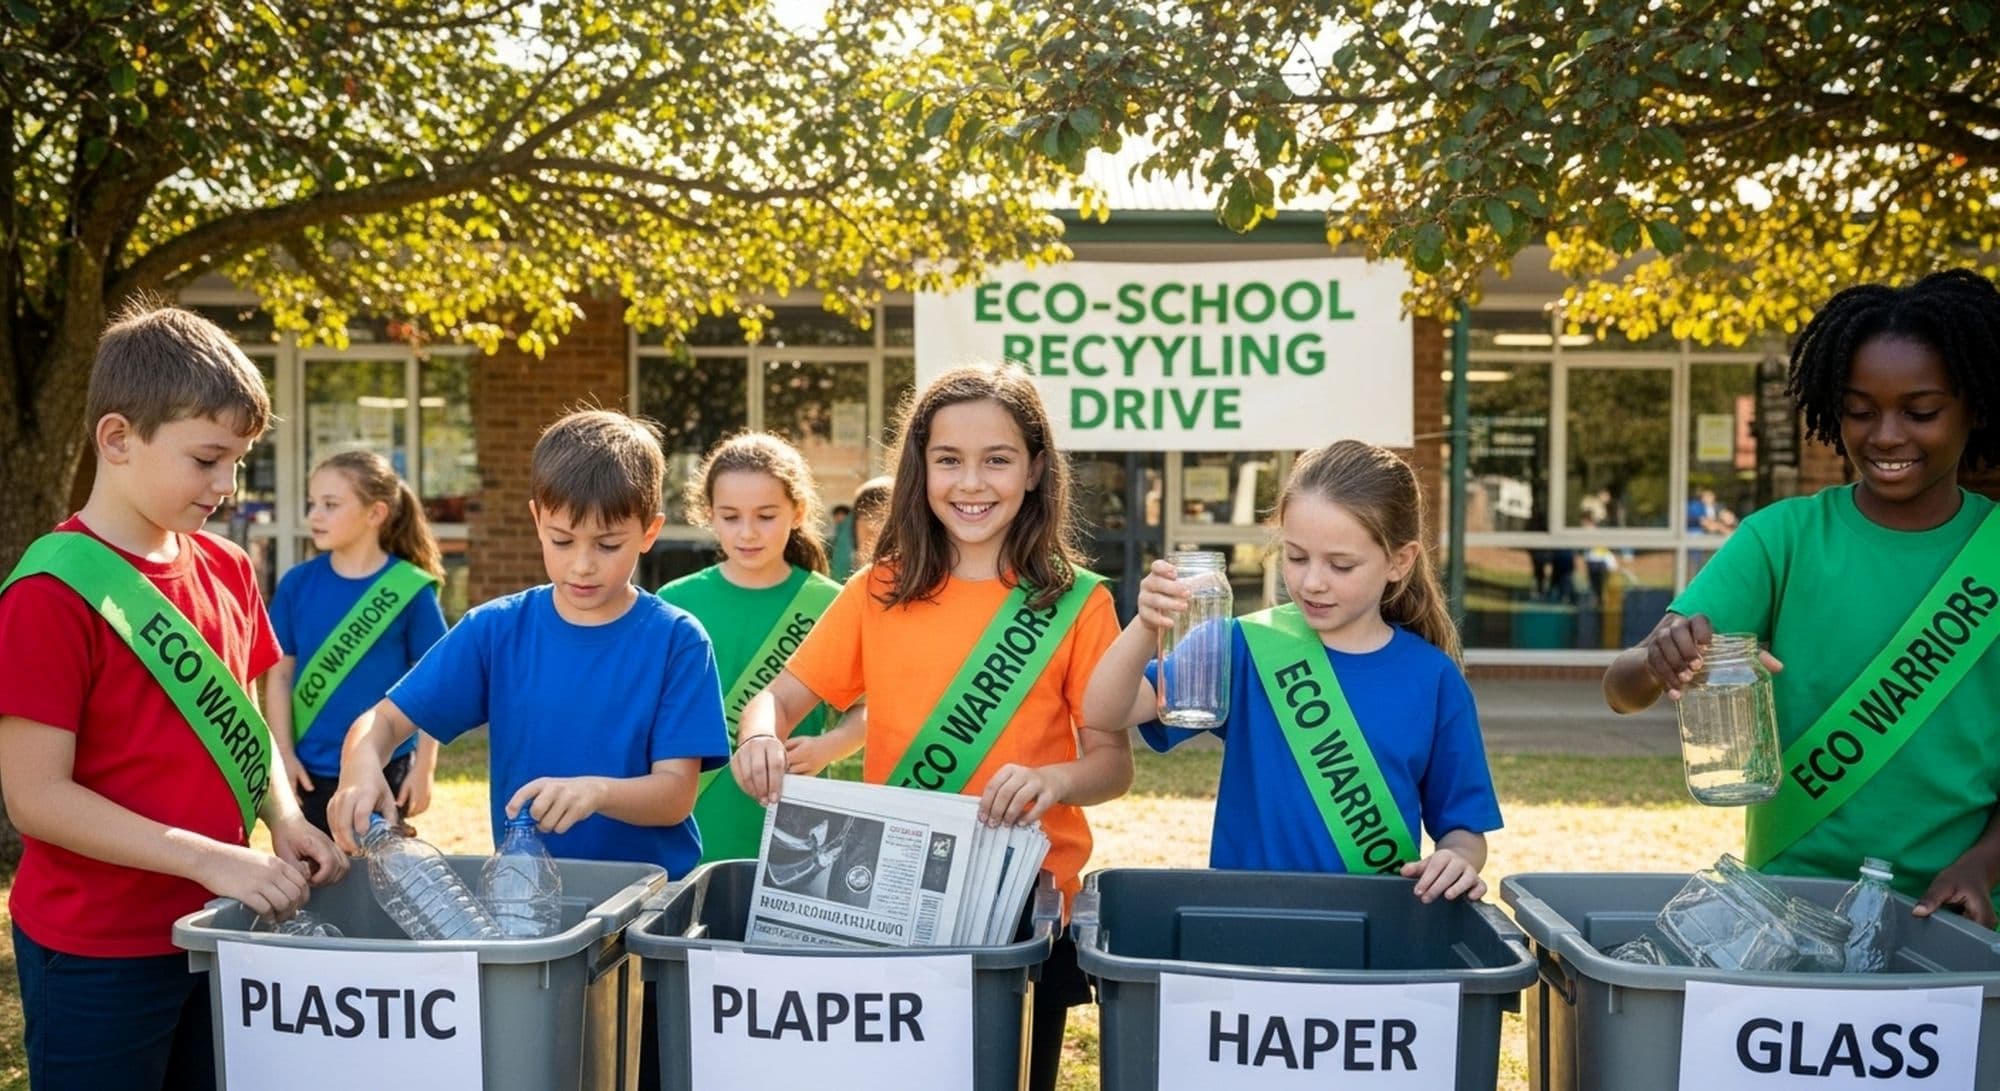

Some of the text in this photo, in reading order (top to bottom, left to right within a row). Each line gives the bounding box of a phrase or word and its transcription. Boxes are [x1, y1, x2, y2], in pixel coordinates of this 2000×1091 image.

[975, 280, 1355, 325] ECO-SCHOOL
[1003, 333, 1326, 377] RECYYLING
[1071, 388, 1242, 431] DRIVE
[139, 612, 203, 684] ECO
[299, 587, 400, 708] ECO WARRIORS
[1274, 659, 1331, 729] ECO
[1790, 576, 1998, 800] ECO WARRIORS
[900, 743, 958, 790] CO
[241, 976, 457, 1039] PLASTIC
[712, 985, 925, 1043] PLAPER
[1209, 1010, 1418, 1071] HAPER
[1736, 1016, 1940, 1079] GLASS
